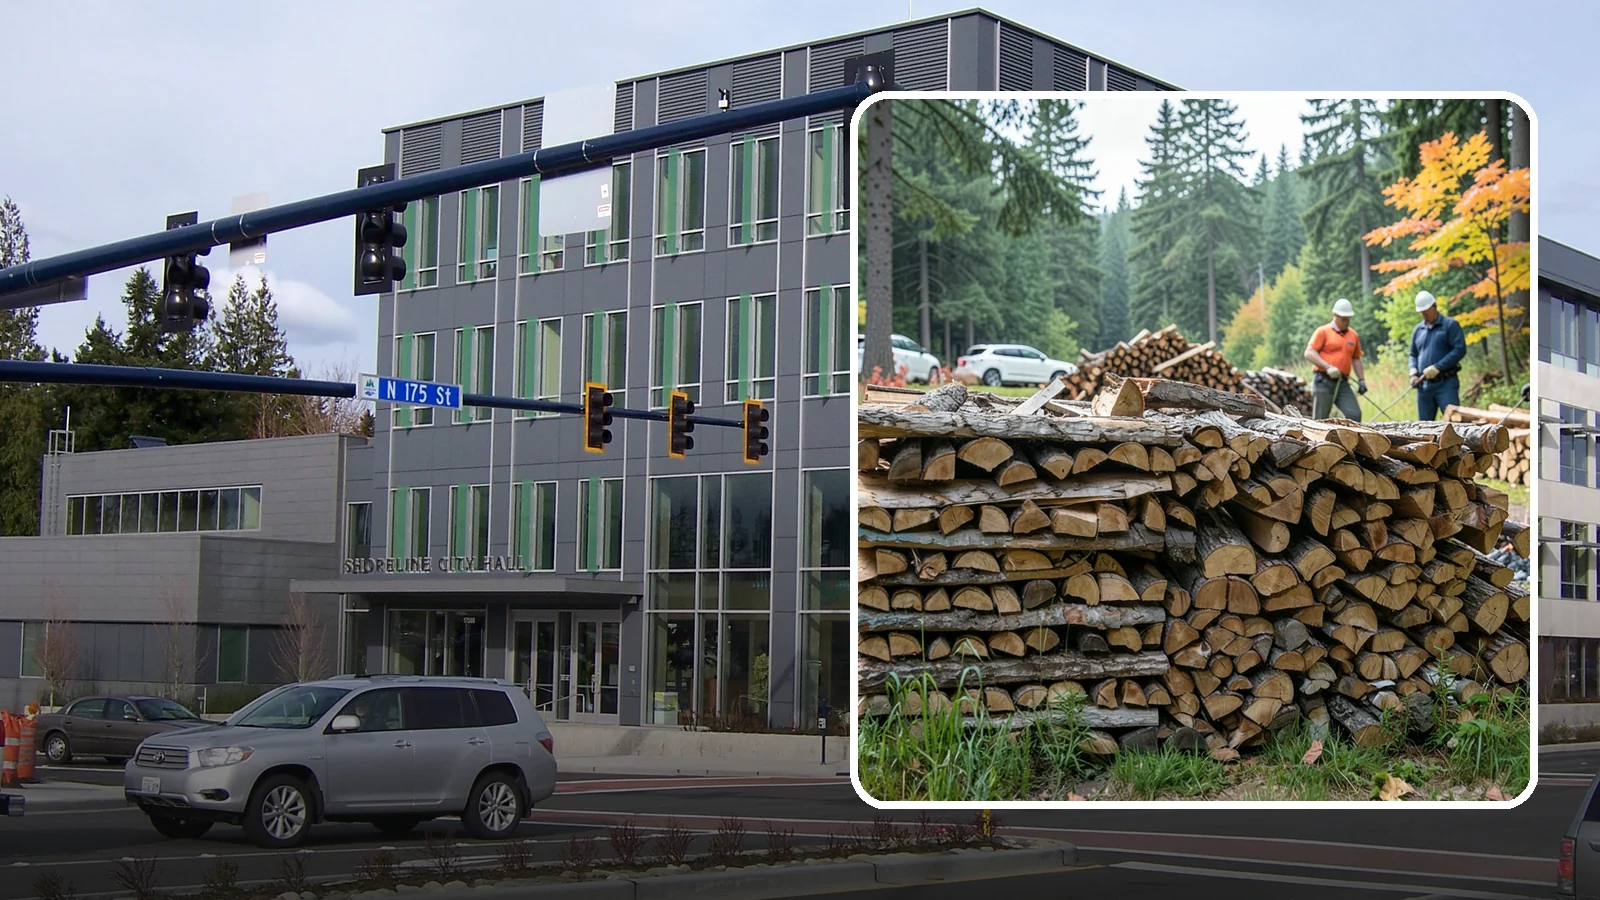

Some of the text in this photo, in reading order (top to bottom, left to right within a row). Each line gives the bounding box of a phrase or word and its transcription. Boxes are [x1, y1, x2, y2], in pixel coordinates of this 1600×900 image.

[387, 380, 452, 406] N 175 St
[343, 556, 526, 574] SHORELINE CITY HALL
